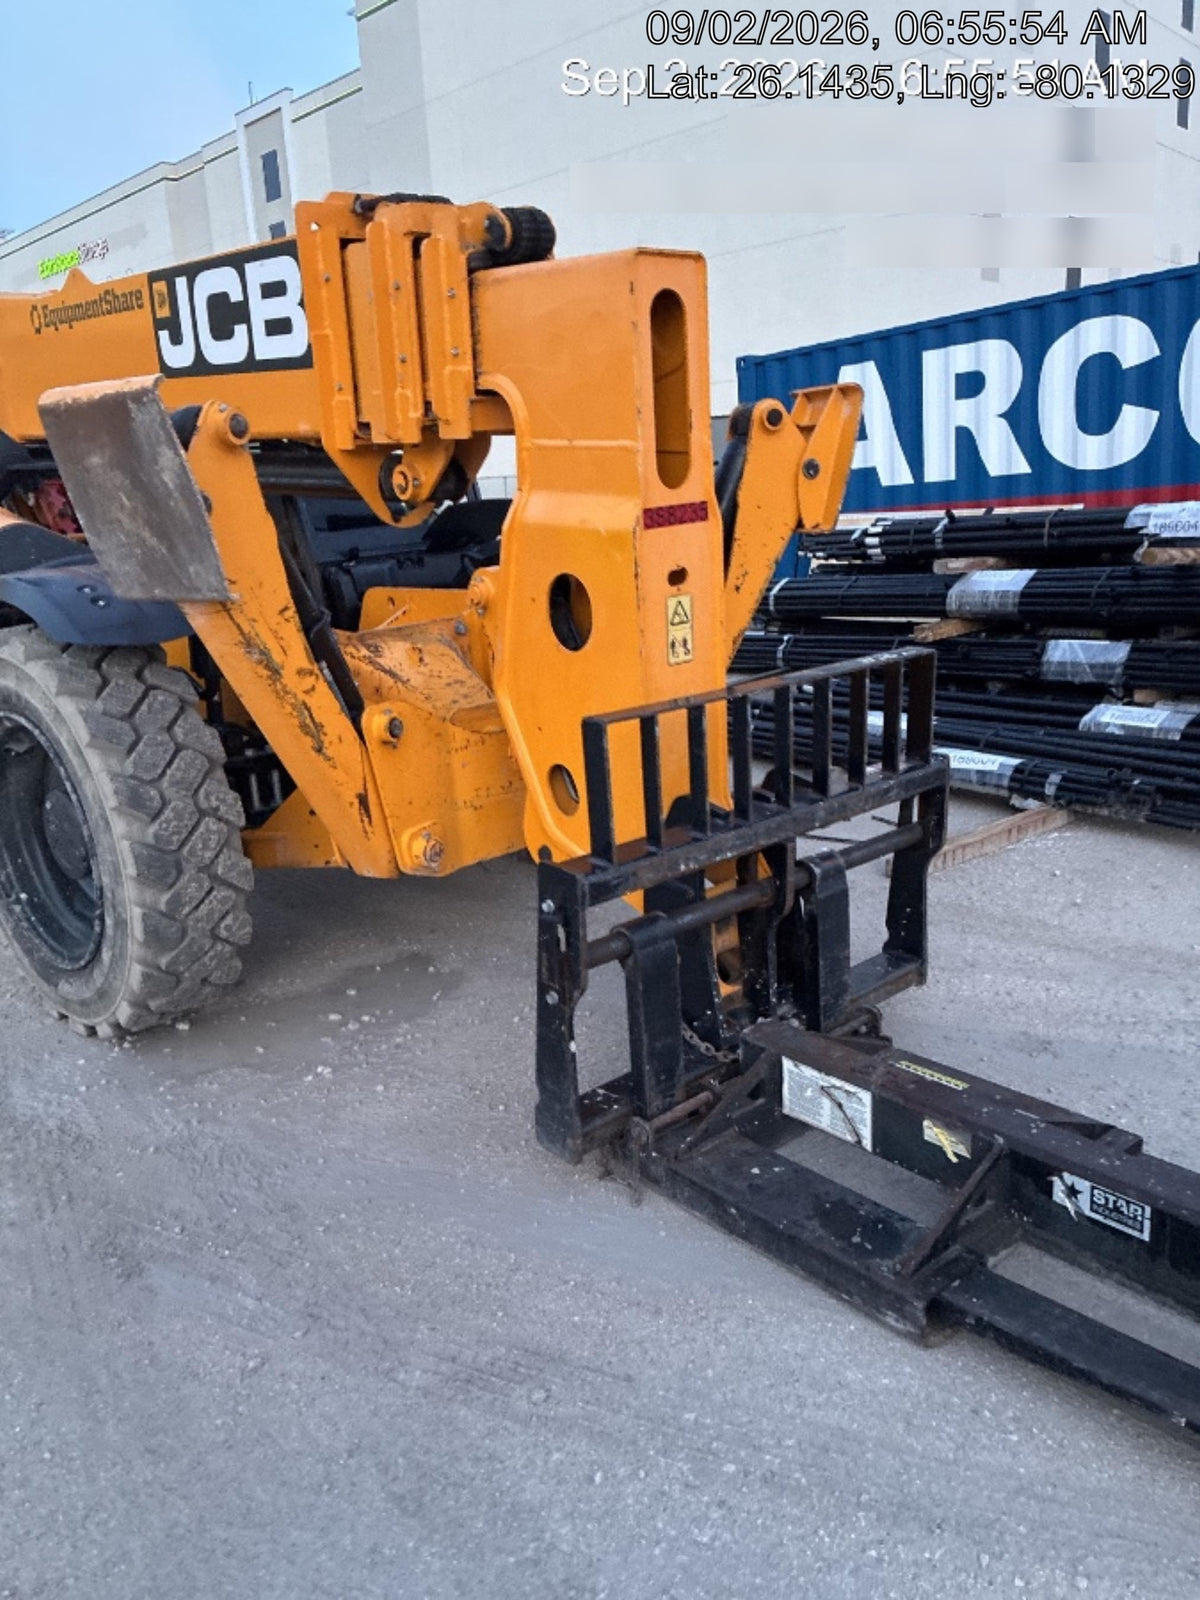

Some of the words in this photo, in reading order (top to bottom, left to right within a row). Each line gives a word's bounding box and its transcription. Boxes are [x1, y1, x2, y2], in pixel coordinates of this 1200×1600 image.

[42, 288, 144, 331] EquipmentShare
[158, 255, 309, 369] JCB
[837, 314, 1200, 487] ARC
[1092, 1188, 1143, 1221] STAR
